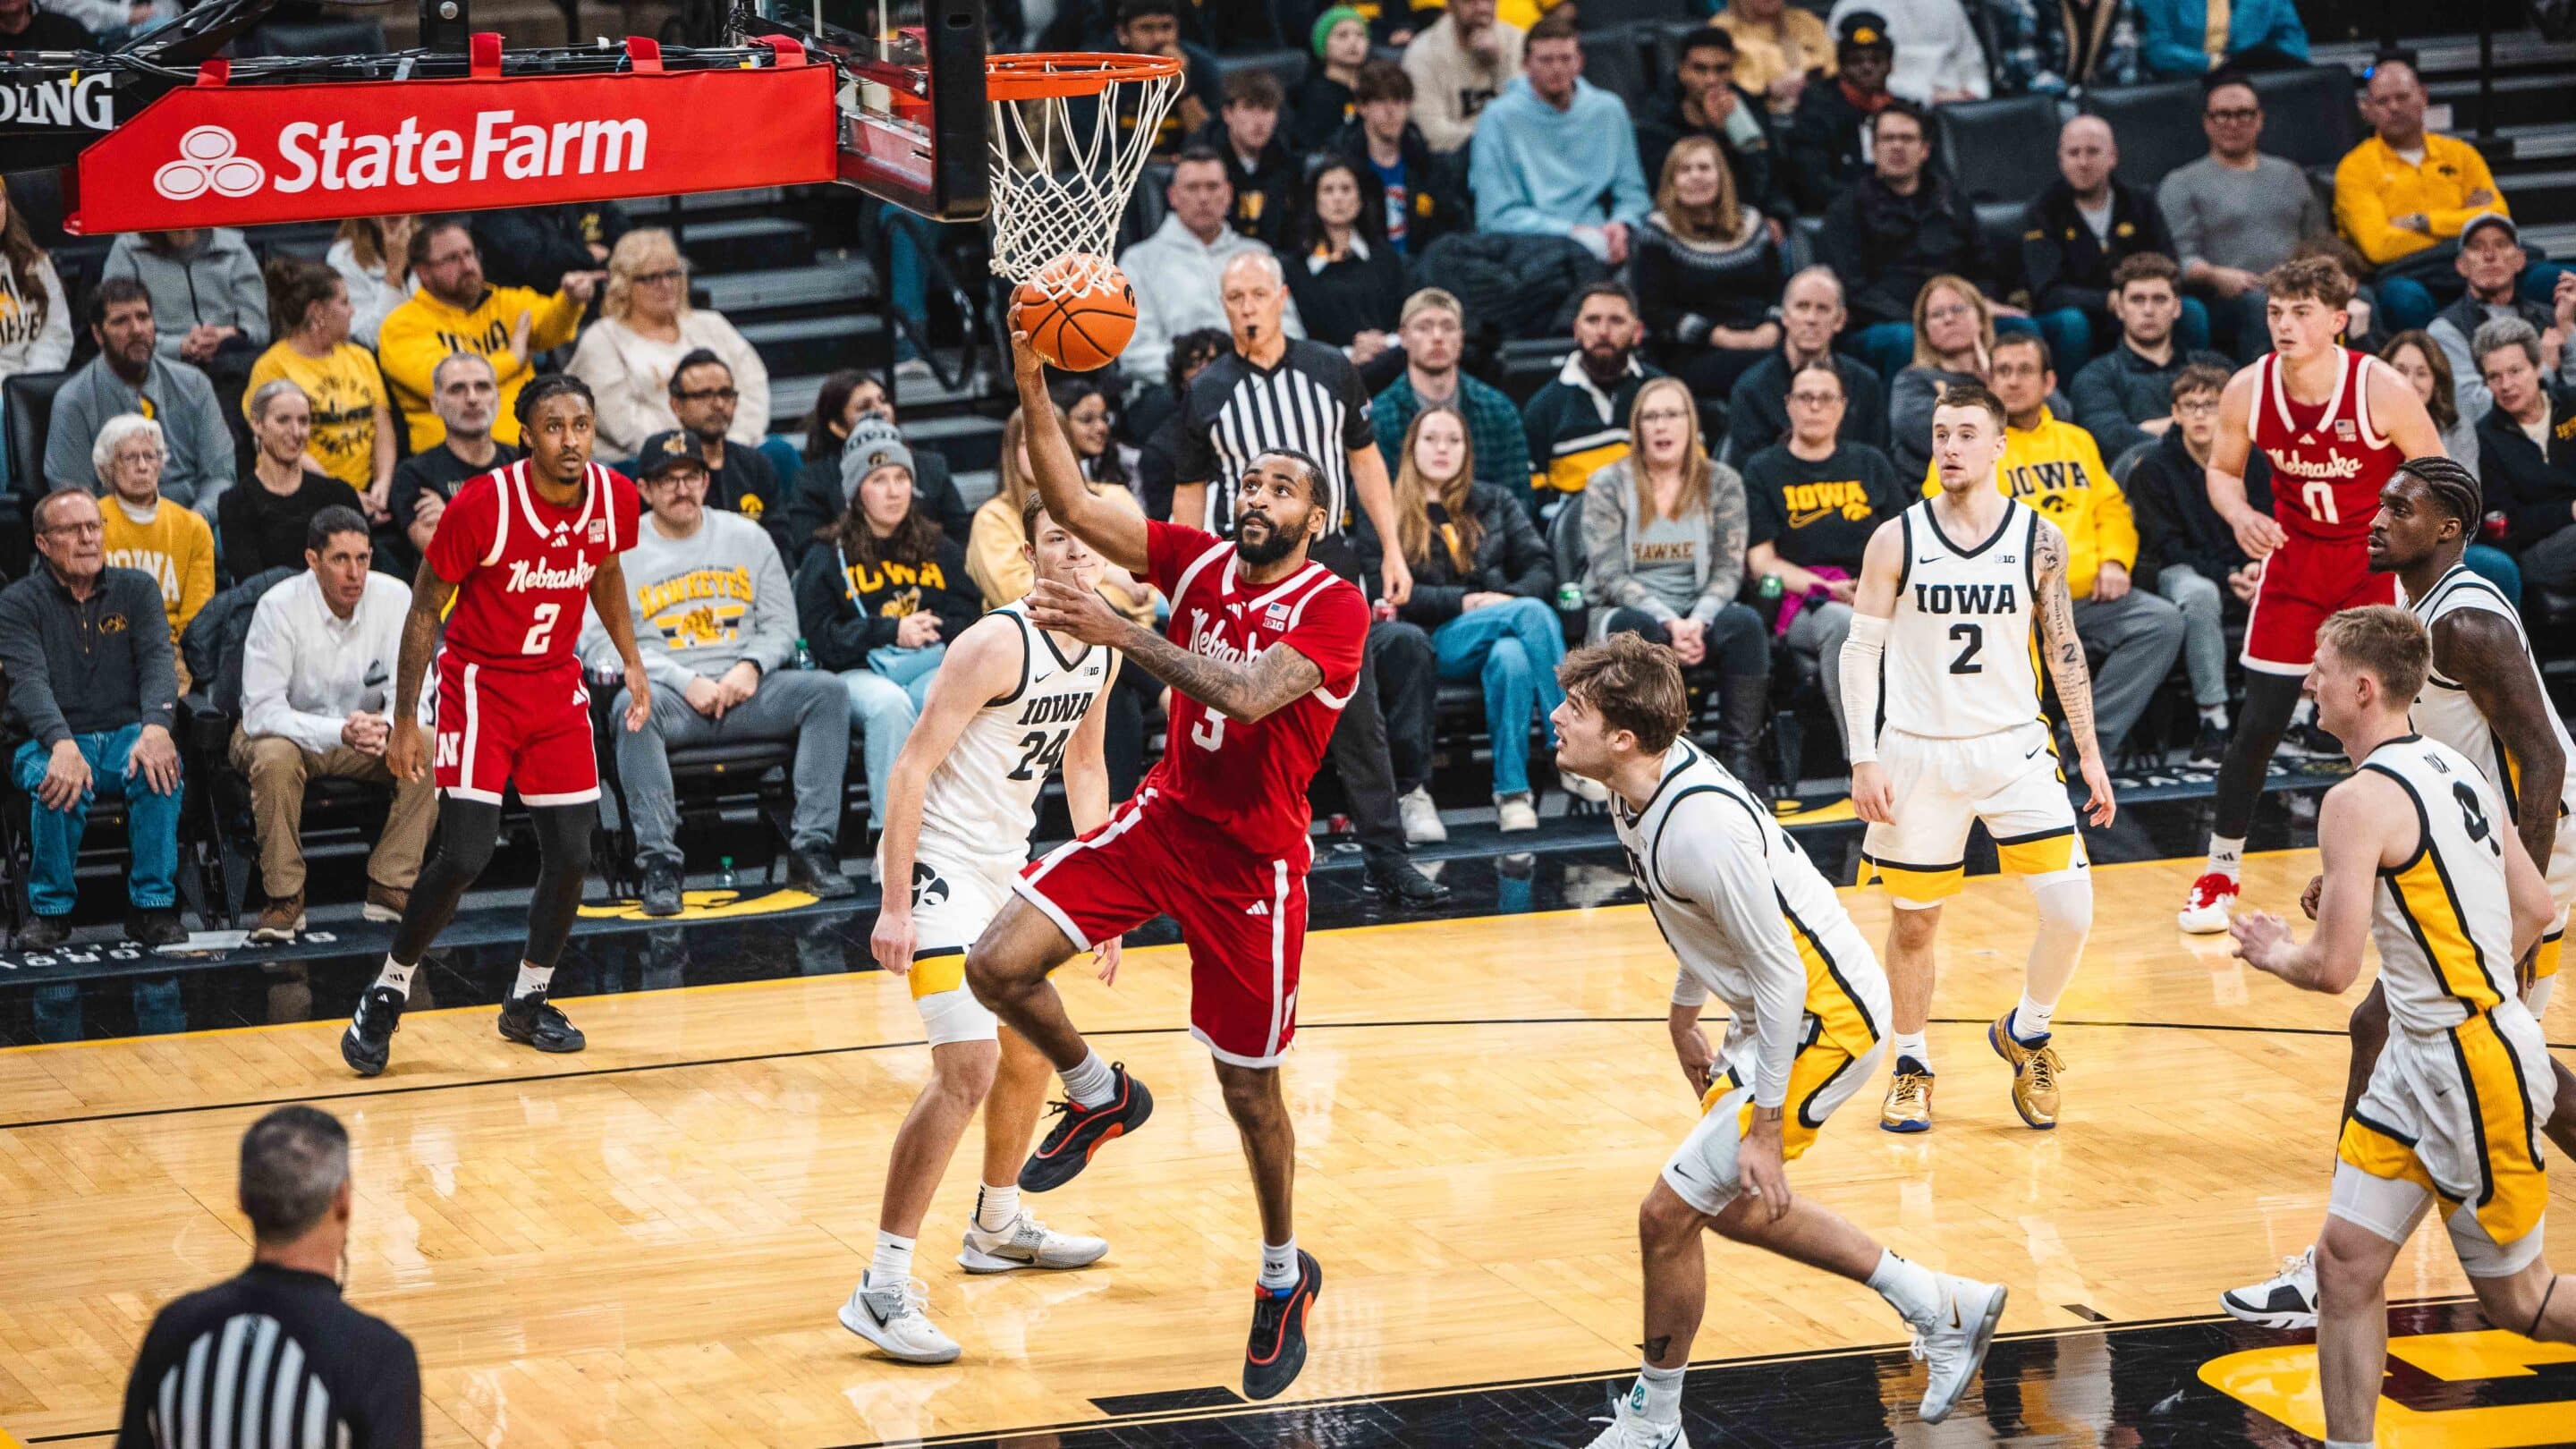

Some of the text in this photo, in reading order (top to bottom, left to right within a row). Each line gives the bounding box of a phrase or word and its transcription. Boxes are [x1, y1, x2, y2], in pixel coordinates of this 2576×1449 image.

[274, 109, 648, 193] State Farm
[2006, 461, 2090, 498] IOWA
[2266, 446, 2363, 479] Nebraska
[1782, 479, 1868, 511] IOWA
[505, 547, 597, 593] Nebraska
[637, 564, 753, 621] HAWKEYES
[844, 560, 946, 601] IOWA
[1914, 583, 2017, 614] IOWA
[521, 602, 562, 656] 2
[1948, 623, 1983, 674] 2
[1016, 691, 1094, 725] IOWA
[1191, 705, 1226, 752] 3
[1006, 728, 1071, 781] 24
[2453, 780, 2502, 858] 4
